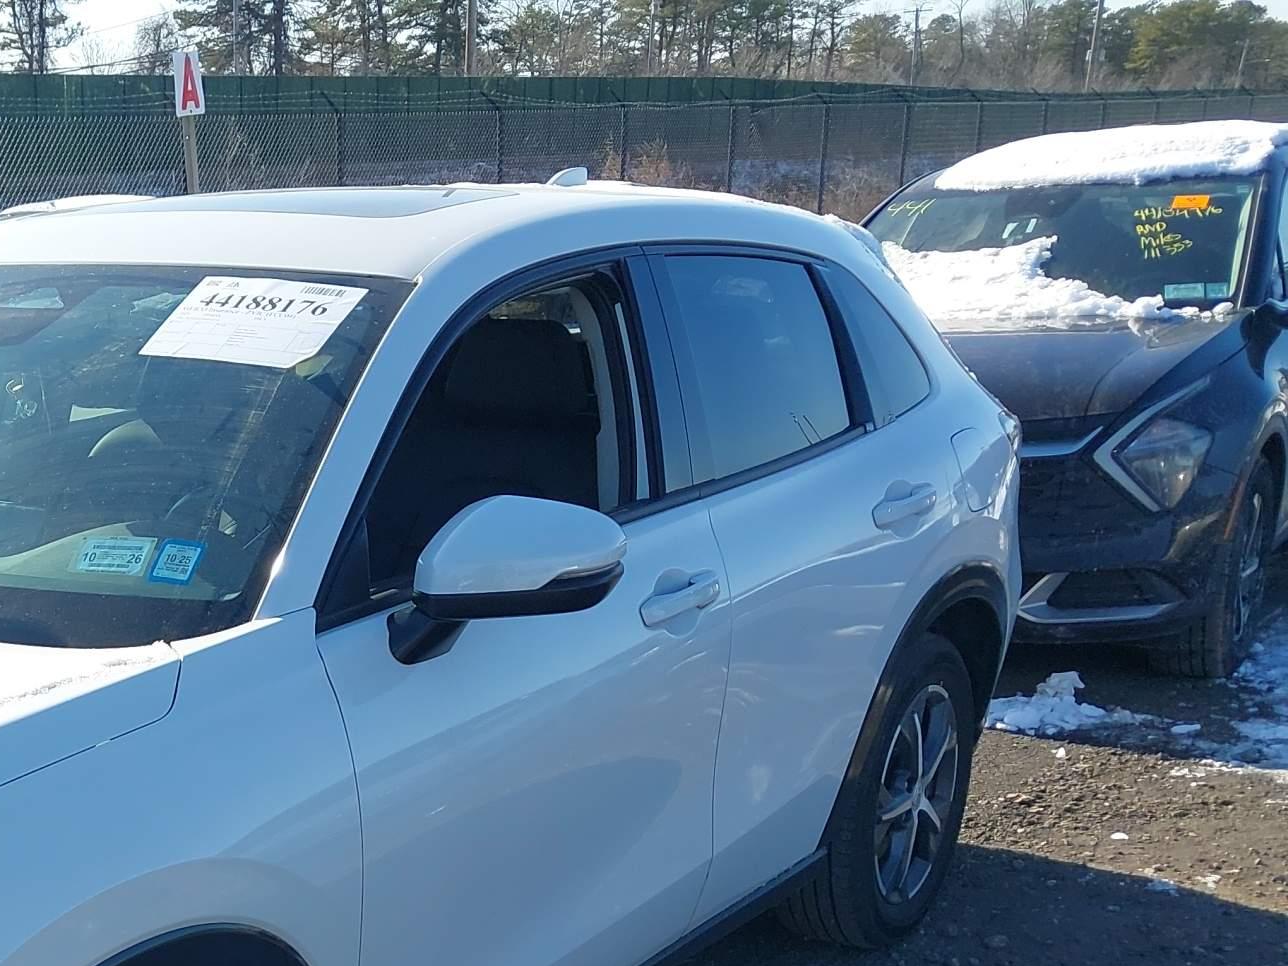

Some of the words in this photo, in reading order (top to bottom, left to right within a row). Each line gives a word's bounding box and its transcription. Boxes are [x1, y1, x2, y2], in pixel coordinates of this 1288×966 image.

[182, 53, 200, 111] A
[200, 292, 333, 316] 44188176
[82, 552, 97, 562] 10
[127, 553, 144, 564] 26
[166, 553, 177, 563] 10
